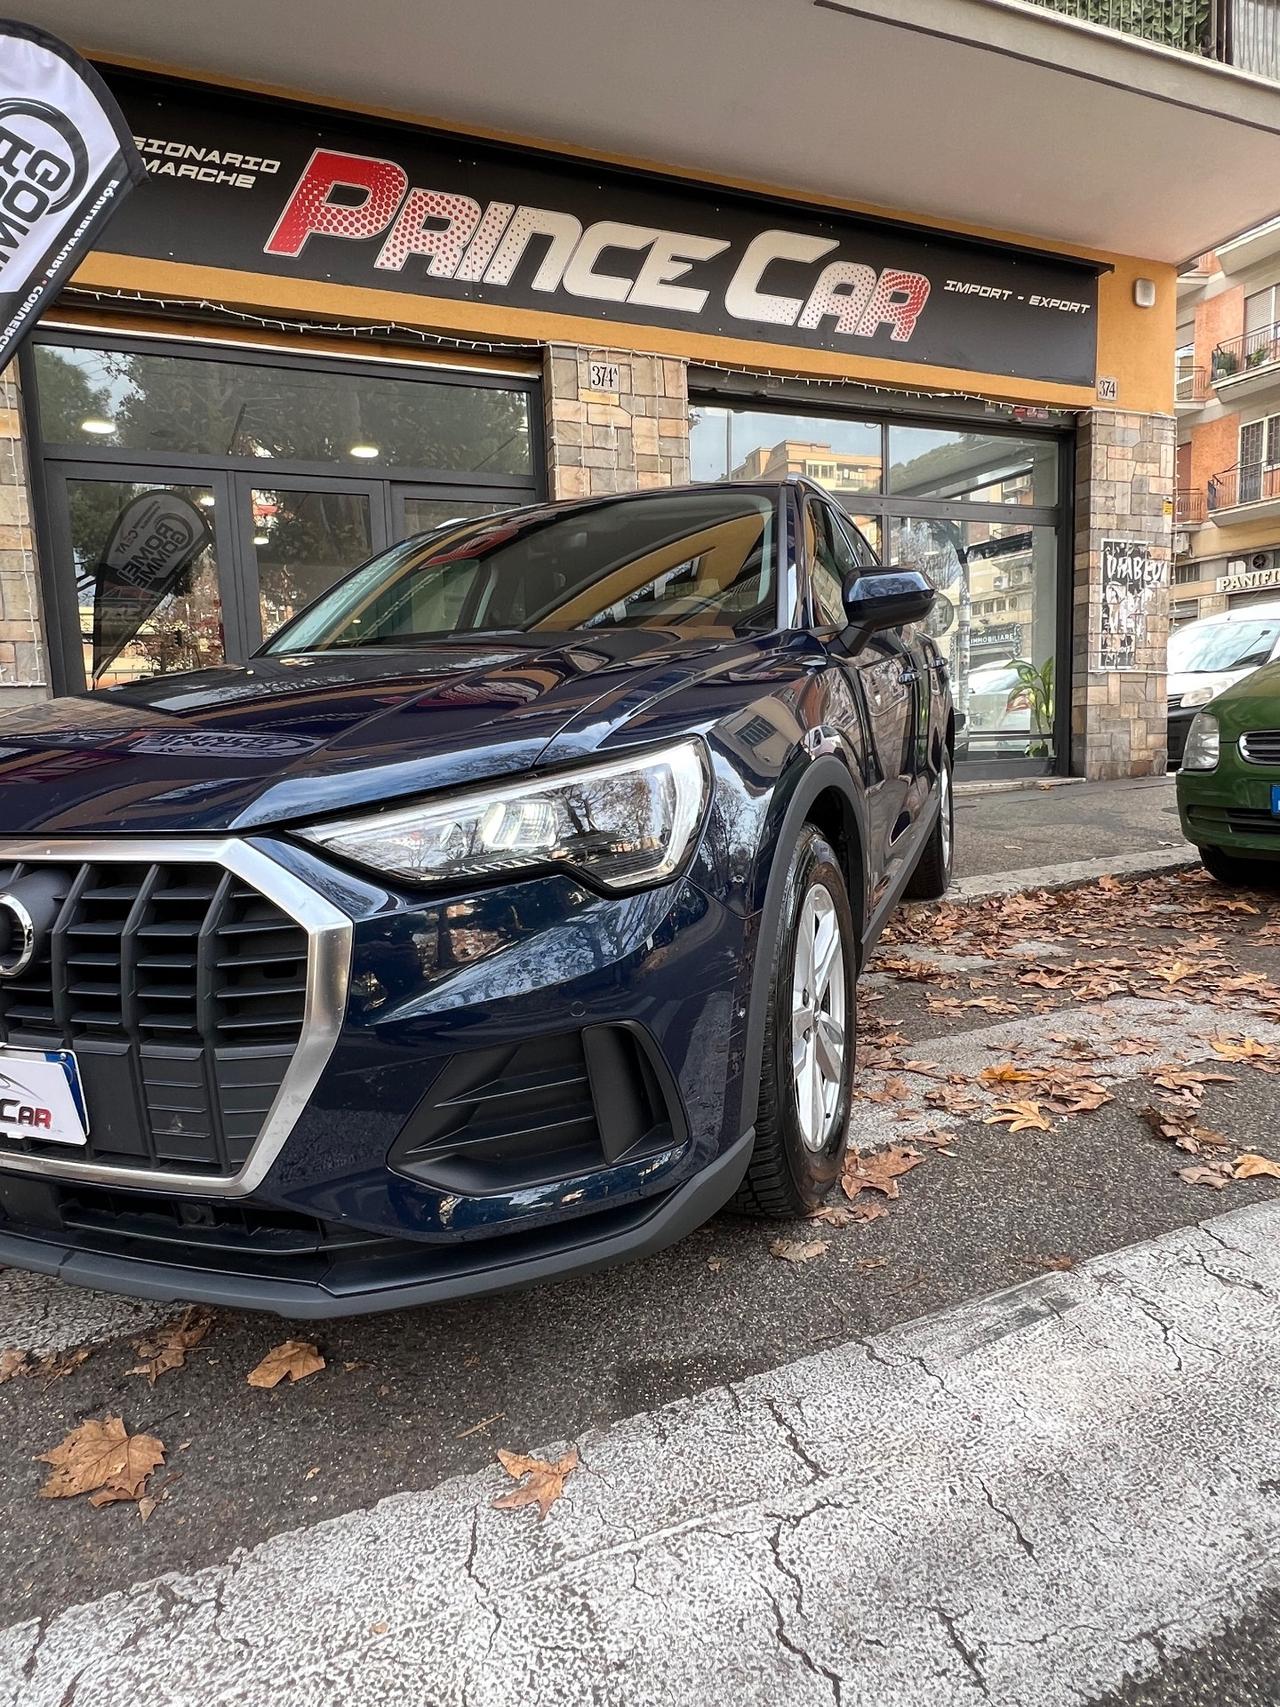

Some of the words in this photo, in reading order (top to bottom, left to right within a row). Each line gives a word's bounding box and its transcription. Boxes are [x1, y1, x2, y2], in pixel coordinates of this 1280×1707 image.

[142, 157, 256, 189] MARCHE
[263, 147, 731, 313] PRINCE
[724, 229, 931, 342] CAR
[944, 280, 1013, 301] IMPORT
[1029, 295, 1091, 314] EXPORT
[1100, 380, 1116, 398] 374
[970, 633, 1014, 644] IMMOBILIARE
[0, 1098, 52, 1130] CAR
